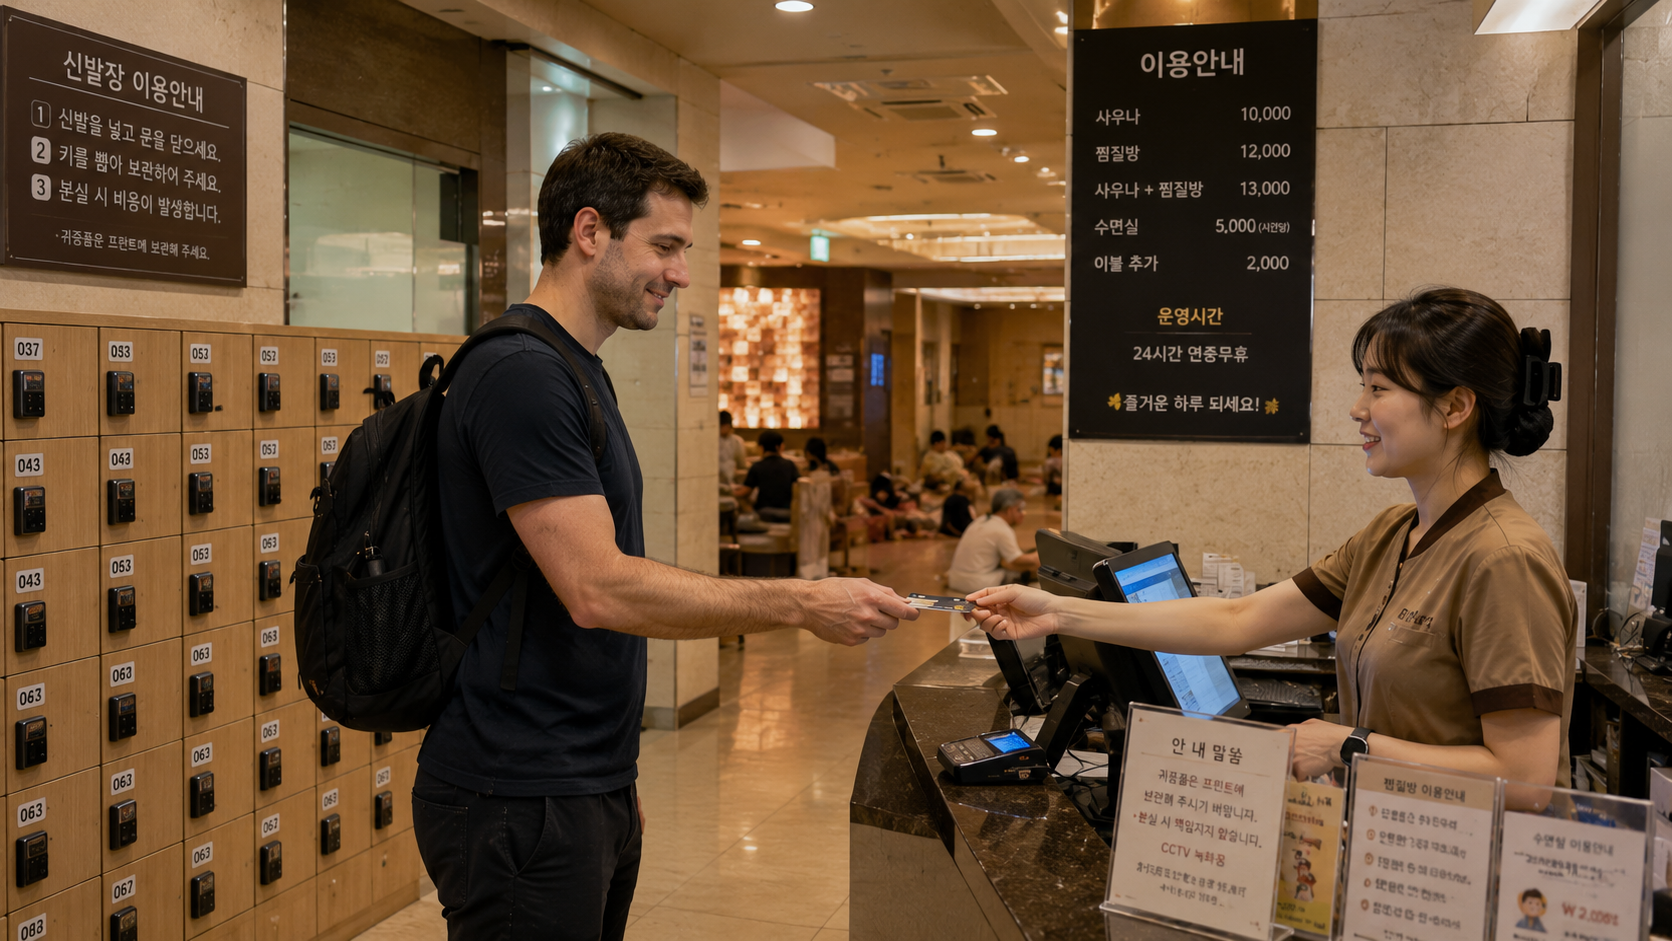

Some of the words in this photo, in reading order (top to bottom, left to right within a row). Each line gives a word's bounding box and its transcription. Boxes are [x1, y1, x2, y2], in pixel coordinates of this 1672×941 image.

[1141, 48, 1244, 78] 이용안내
[64, 51, 124, 91] 신발장
[133, 71, 203, 113] 이용안내
[1096, 108, 1140, 126] 사우나
[1241, 106, 1291, 123] 10,000
[59, 108, 102, 137] 신발을
[109, 119, 135, 142] 넣고
[140, 128, 165, 151] 문을
[171, 134, 221, 162] 닫으세요.
[1096, 145, 1140, 162] 찜질방
[1241, 143, 1290, 160] 12,000
[183, 169, 221, 193] 주세요.
[1095, 182, 1139, 199] 사우나
[1144, 185, 1153, 195] +
[1159, 181, 1203, 198] 찜질방
[1240, 181, 1290, 197] 13,000
[95, 187, 107, 207] 시
[158, 197, 221, 223] 발생합니다.
[1094, 219, 1138, 235] 수면실
[1216, 218, 1256, 234] 5,000
[1094, 256, 1123, 272] 이불
[1129, 255, 1158, 272] 추가
[1247, 256, 1289, 272] 2,000
[1157, 307, 1223, 326] 운영시간
[17, 342, 39, 356] 037
[192, 348, 209, 360] 053
[1133, 345, 1182, 363] 24시간
[1188, 345, 1248, 363] 연중무휴
[1124, 394, 1168, 412] 즐거운
[1174, 395, 1204, 412] 하루
[1209, 395, 1259, 412] 되세요!
[192, 448, 209, 460] 053
[18, 458, 40, 473] 043
[19, 573, 41, 589] 043
[193, 647, 209, 661] 063
[113, 666, 132, 682] 063
[20, 688, 42, 706] 063
[263, 724, 277, 737] 063
[194, 747, 210, 762] 063
[113, 774, 132, 790] 063
[20, 803, 42, 822] 063
[1177, 795, 1208, 813] 주시기
[1160, 815, 1171, 828] 시
[194, 847, 210, 863] 063
[1161, 842, 1191, 858] CCTV
